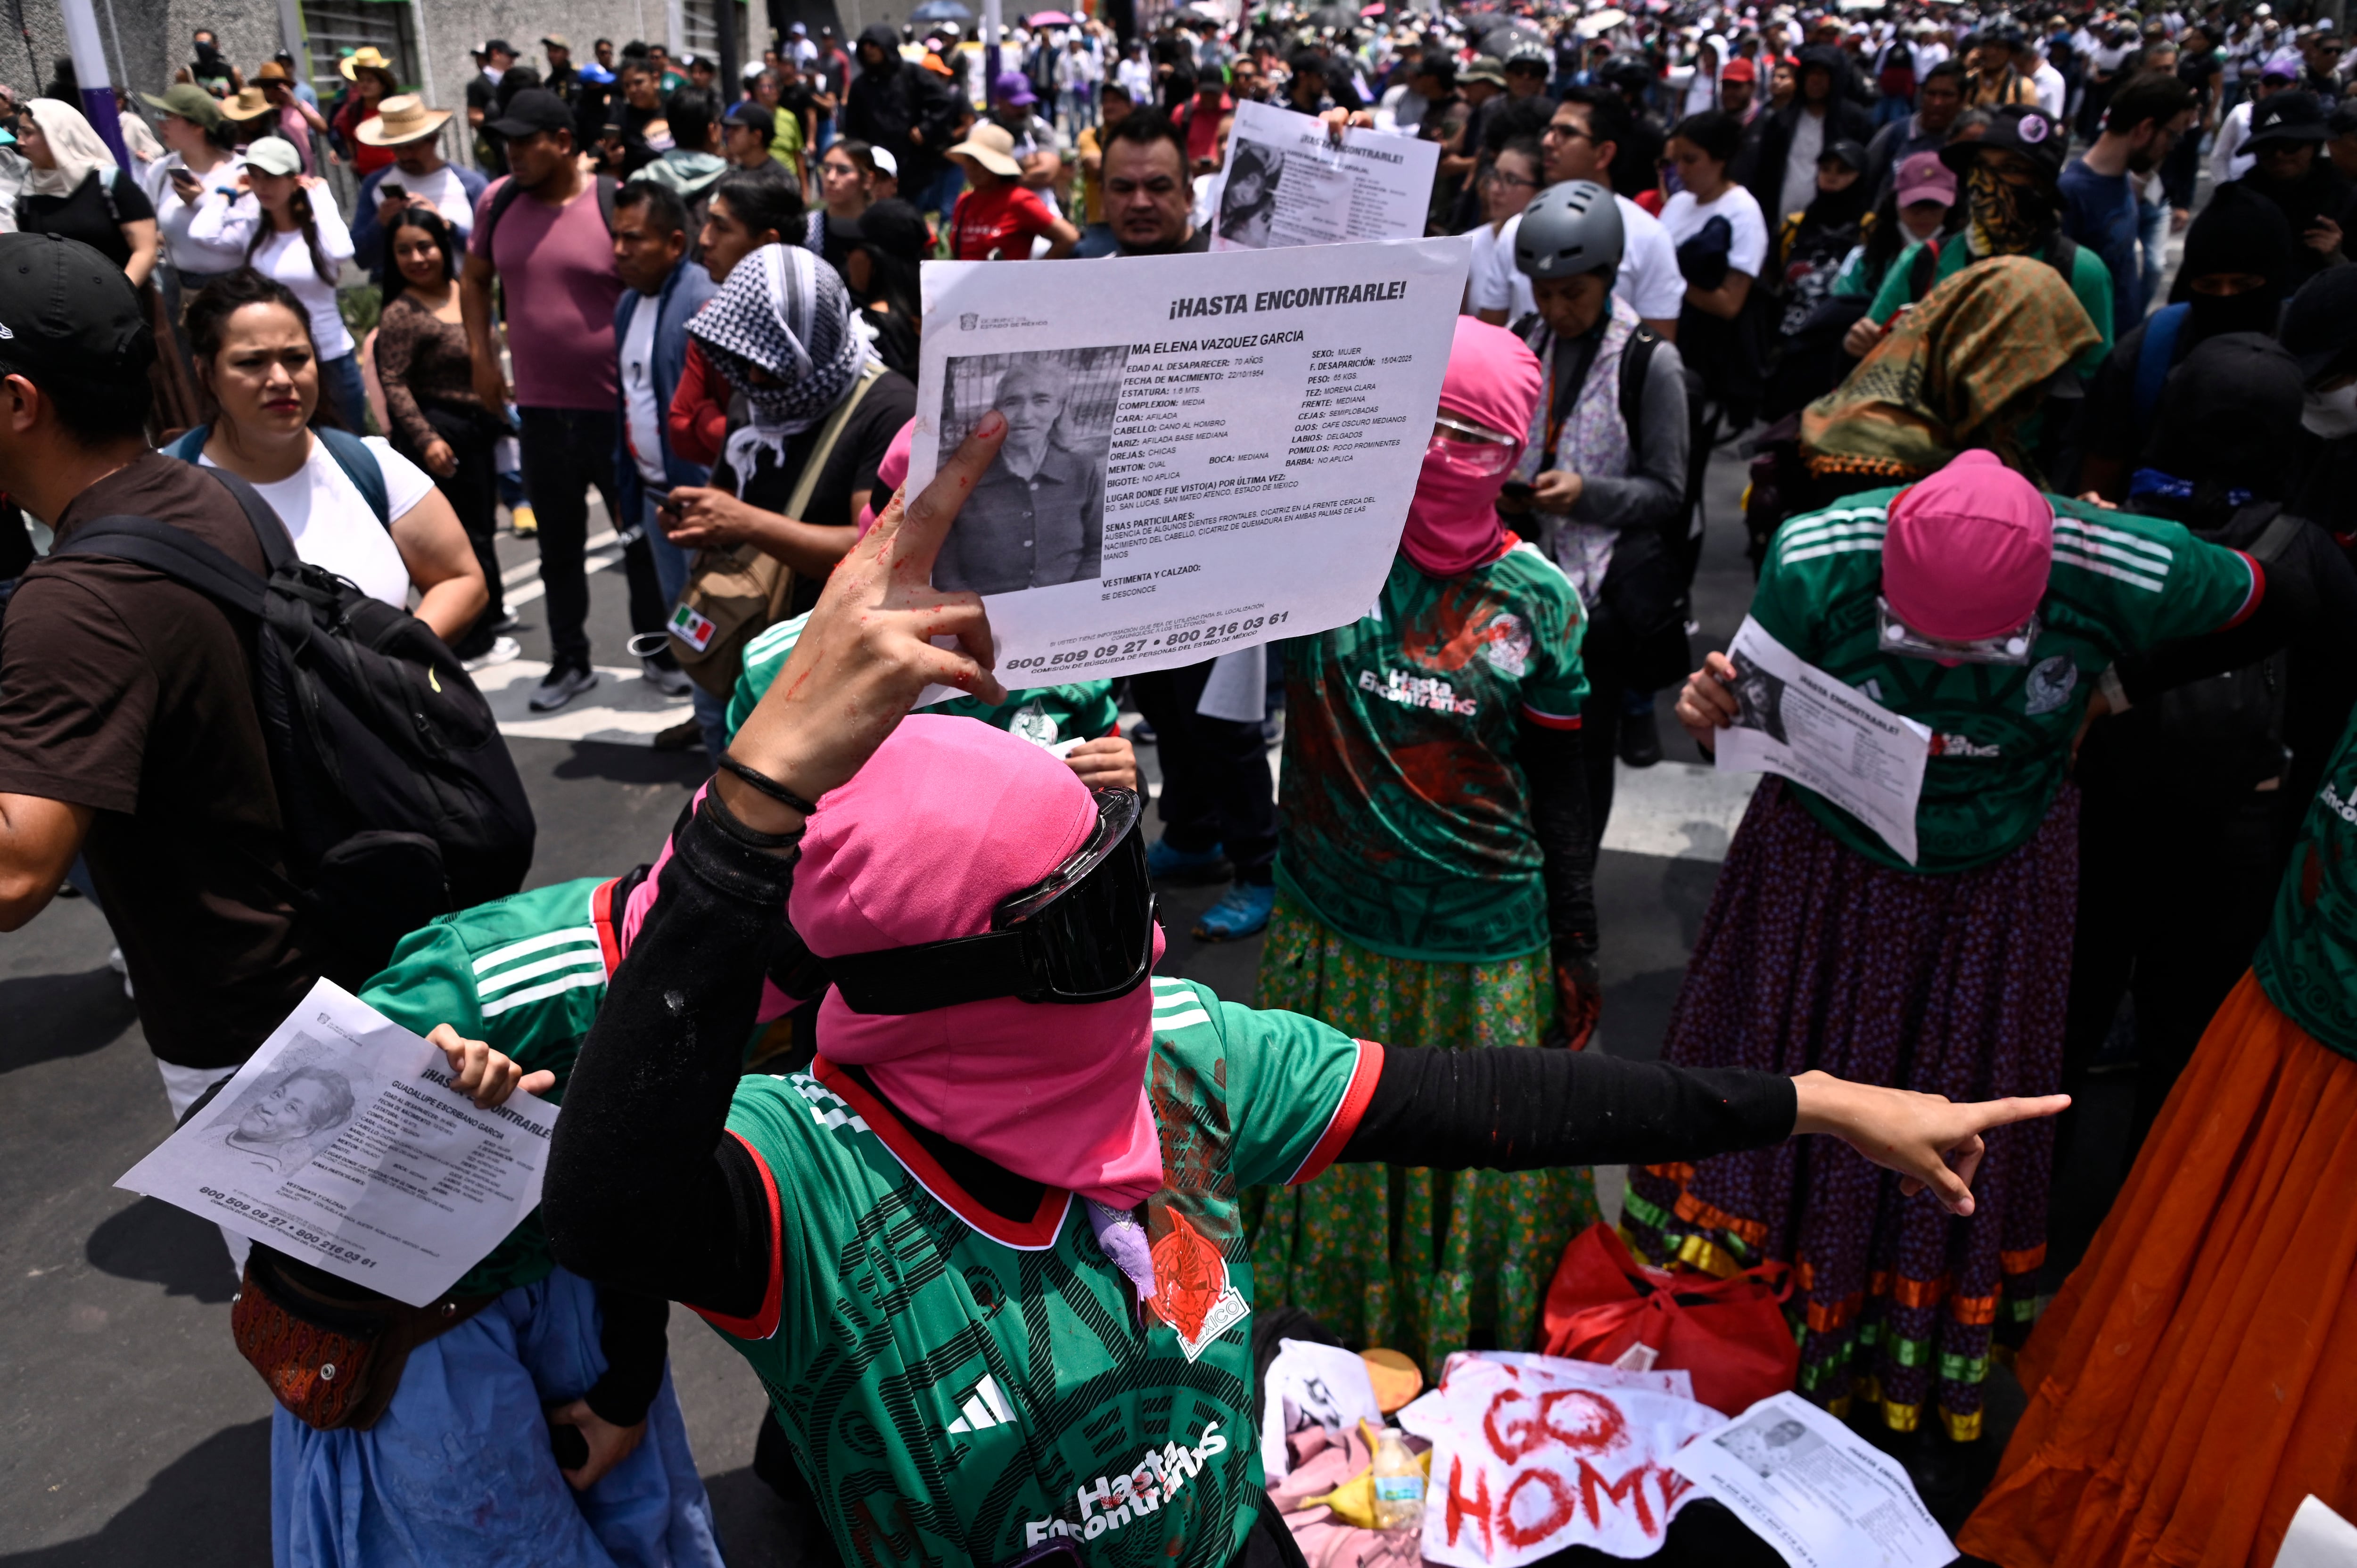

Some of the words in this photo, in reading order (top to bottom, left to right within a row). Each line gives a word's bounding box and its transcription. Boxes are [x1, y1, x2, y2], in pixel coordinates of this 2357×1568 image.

[1170, 294, 1247, 320] ¡HASTA
[1255, 281, 1407, 312] ENCONTRARLE!
[1132, 344, 1150, 354] MA
[1154, 341, 1197, 353] ELENA
[1202, 336, 1258, 350] VAZQUEZ
[1261, 330, 1304, 345] GARCIA
[1312, 350, 1334, 358] SEXO:
[1167, 360, 1229, 370] DESAPARECER:
[1244, 356, 1263, 364] AÑOS
[1318, 357, 1376, 370] DESAPARICIÓN:
[1381, 355, 1412, 364] 15/04/2025
[1168, 373, 1224, 382] NACIMIENTO:
[1308, 375, 1329, 384] PESO:
[1122, 388, 1169, 397] ESTATURA:
[1119, 400, 1178, 410] COMPLEXION:
[1302, 400, 1332, 408] FRENTE:
[1336, 396, 1365, 404] MEDIANA
[1298, 412, 1326, 420] CEJAS:
[1114, 425, 1156, 435] CABELLO:
[1194, 420, 1225, 428] HOMBRO
[1294, 424, 1318, 432] OJOS:
[1342, 419, 1370, 427] OSCURO
[1372, 416, 1407, 424] MEDIANOS
[1112, 439, 1139, 448] NARIZ:
[1142, 435, 1173, 445] AFILADA
[1292, 435, 1323, 443] LABIOS:
[1327, 432, 1362, 440] DELGADOS
[1110, 451, 1145, 461] OREJAS:
[1148, 447, 1176, 456] CHICAS
[1289, 445, 1329, 454] POMULOS:
[1354, 440, 1400, 449] PROMINENTES
[1237, 453, 1269, 461] MEDIANA
[1286, 458, 1314, 467] BARBA:
[1109, 464, 1145, 474] MENTON:
[1107, 478, 1139, 487] BIGOTE:
[1155, 472, 1179, 480] APLICA
[1106, 493, 1134, 503] LUGAR
[1137, 490, 1162, 499] DONDE
[1181, 484, 1217, 493] VISTO(A)
[1237, 476, 1266, 485] ÚLTIMA
[1179, 493, 1202, 501] MATEO
[1235, 486, 1261, 494] ESTADO
[1105, 531, 1141, 541] AUSENCIA
[1154, 522, 1187, 533] ALGUNOS
[1189, 517, 1217, 527] DIENTES
[1261, 507, 1291, 517] CICATRIZ
[1312, 501, 1338, 509] FRENTE
[1134, 512, 1195, 528] PARTICULARES:
[1104, 539, 1148, 550] NACIMIENTO
[1150, 536, 1162, 544] DEL
[1198, 525, 1228, 535] CICATRIZ
[1241, 517, 1283, 528] QUEMADURA
[1319, 509, 1342, 517] PALMAS
[1104, 551, 1129, 560] MANOS
[1103, 573, 1152, 588] VESTIMENTA
[1162, 565, 1201, 577] CALZADO:
[1113, 585, 1156, 599] DESCONOCE
[1006, 657, 1045, 669] 800
[1051, 650, 1088, 665] 509
[1095, 645, 1118, 658] 09
[1123, 639, 1147, 654] 27
[1166, 630, 1200, 646] 800
[1204, 622, 1238, 639] 216
[1244, 617, 1264, 630] 03
[1269, 611, 1289, 625] 61
[1031, 665, 1070, 673] COMISIÓN
[1084, 656, 1125, 667] BÚSQUEDA
[1138, 646, 1177, 658] PERSONAS
[1194, 639, 1220, 649] ESTADO
[1232, 630, 1257, 640] MÉXICO
[392, 1080, 437, 1106] GUADALUPE
[437, 1101, 478, 1126] ESCRIBANO
[478, 1123, 504, 1140] GARCIA
[199, 1186, 225, 1200] 800
[226, 1197, 250, 1211] 509
[252, 1208, 269, 1219] 09
[271, 1216, 287, 1227] 27
[296, 1228, 320, 1244] 800
[321, 1240, 343, 1254] 216
[344, 1249, 360, 1261] 03
[361, 1257, 378, 1268] 61
[1483, 1388, 1631, 1466] GO
[1078, 1440, 1178, 1521] Hasta
